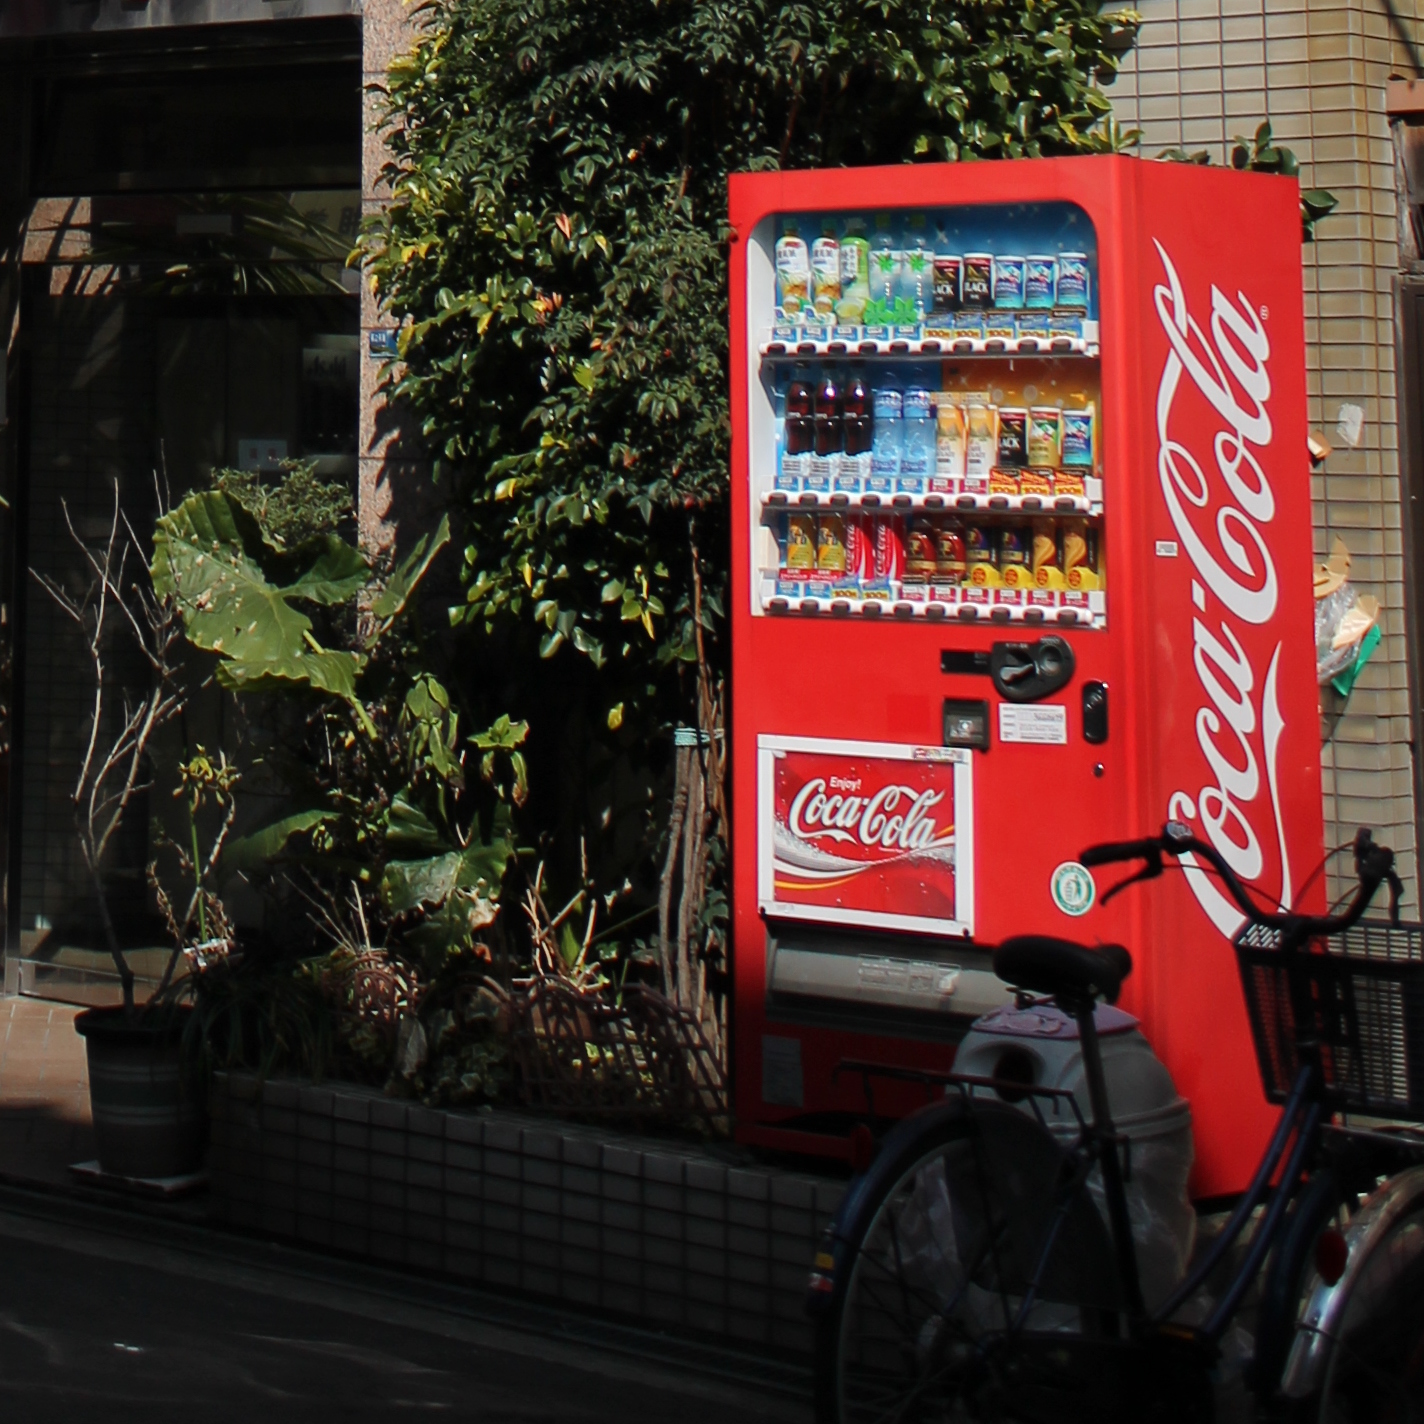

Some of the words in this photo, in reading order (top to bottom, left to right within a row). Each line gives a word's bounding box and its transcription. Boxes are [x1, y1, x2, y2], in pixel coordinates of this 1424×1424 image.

[1152, 236, 1291, 941] Coca-Cola
[789, 777, 946, 850] Coca-Cola
[829, 776, 862, 792] Enjoy!
